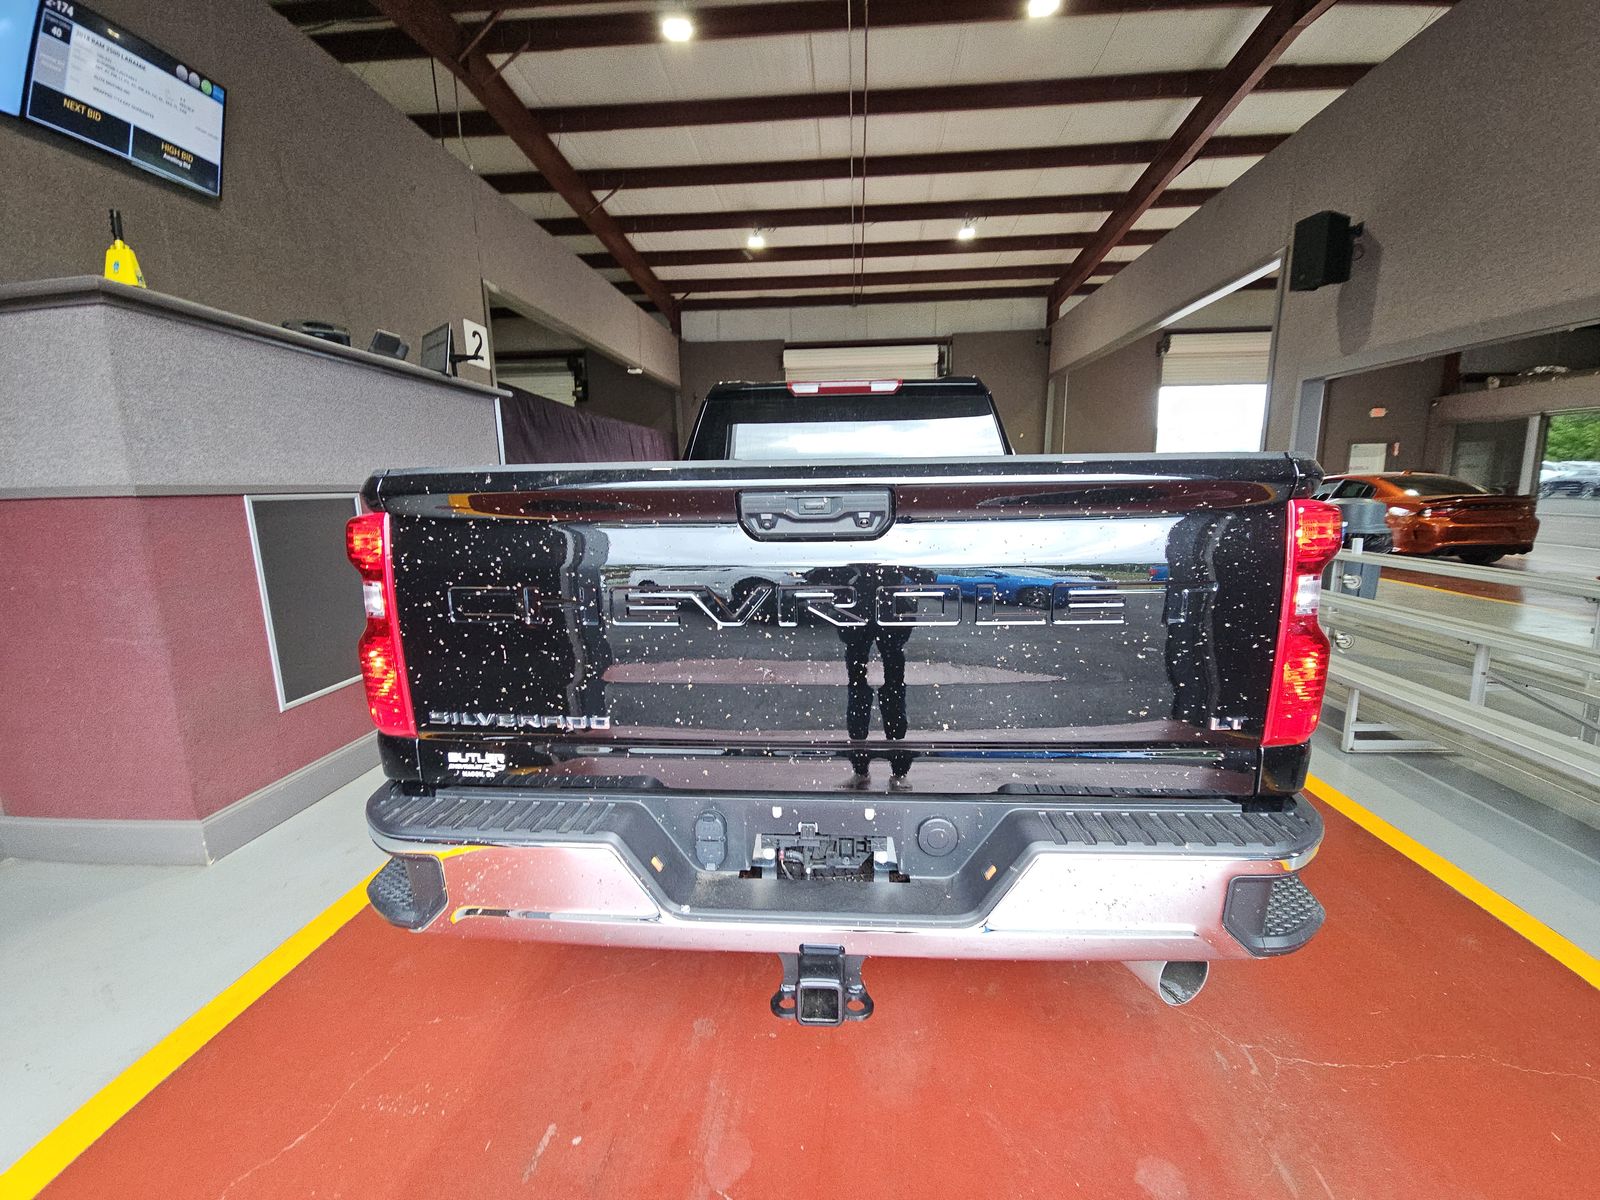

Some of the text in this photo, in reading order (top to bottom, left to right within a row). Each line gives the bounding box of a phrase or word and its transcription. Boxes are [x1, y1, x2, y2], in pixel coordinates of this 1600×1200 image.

[51, 26, 63, 38] 40
[91, 37, 106, 49] RAM
[63, 98, 87, 116] NEXT
[87, 108, 102, 122] BID
[161, 142, 194, 164] HIGH BID
[182, 160, 192, 171] Bid
[471, 330, 485, 361] 2
[447, 582, 1218, 627] CHEVROLET
[429, 711, 611, 730] SILVERADO
[1210, 716, 1249, 731] LT
[448, 752, 505, 764] BUTLER
